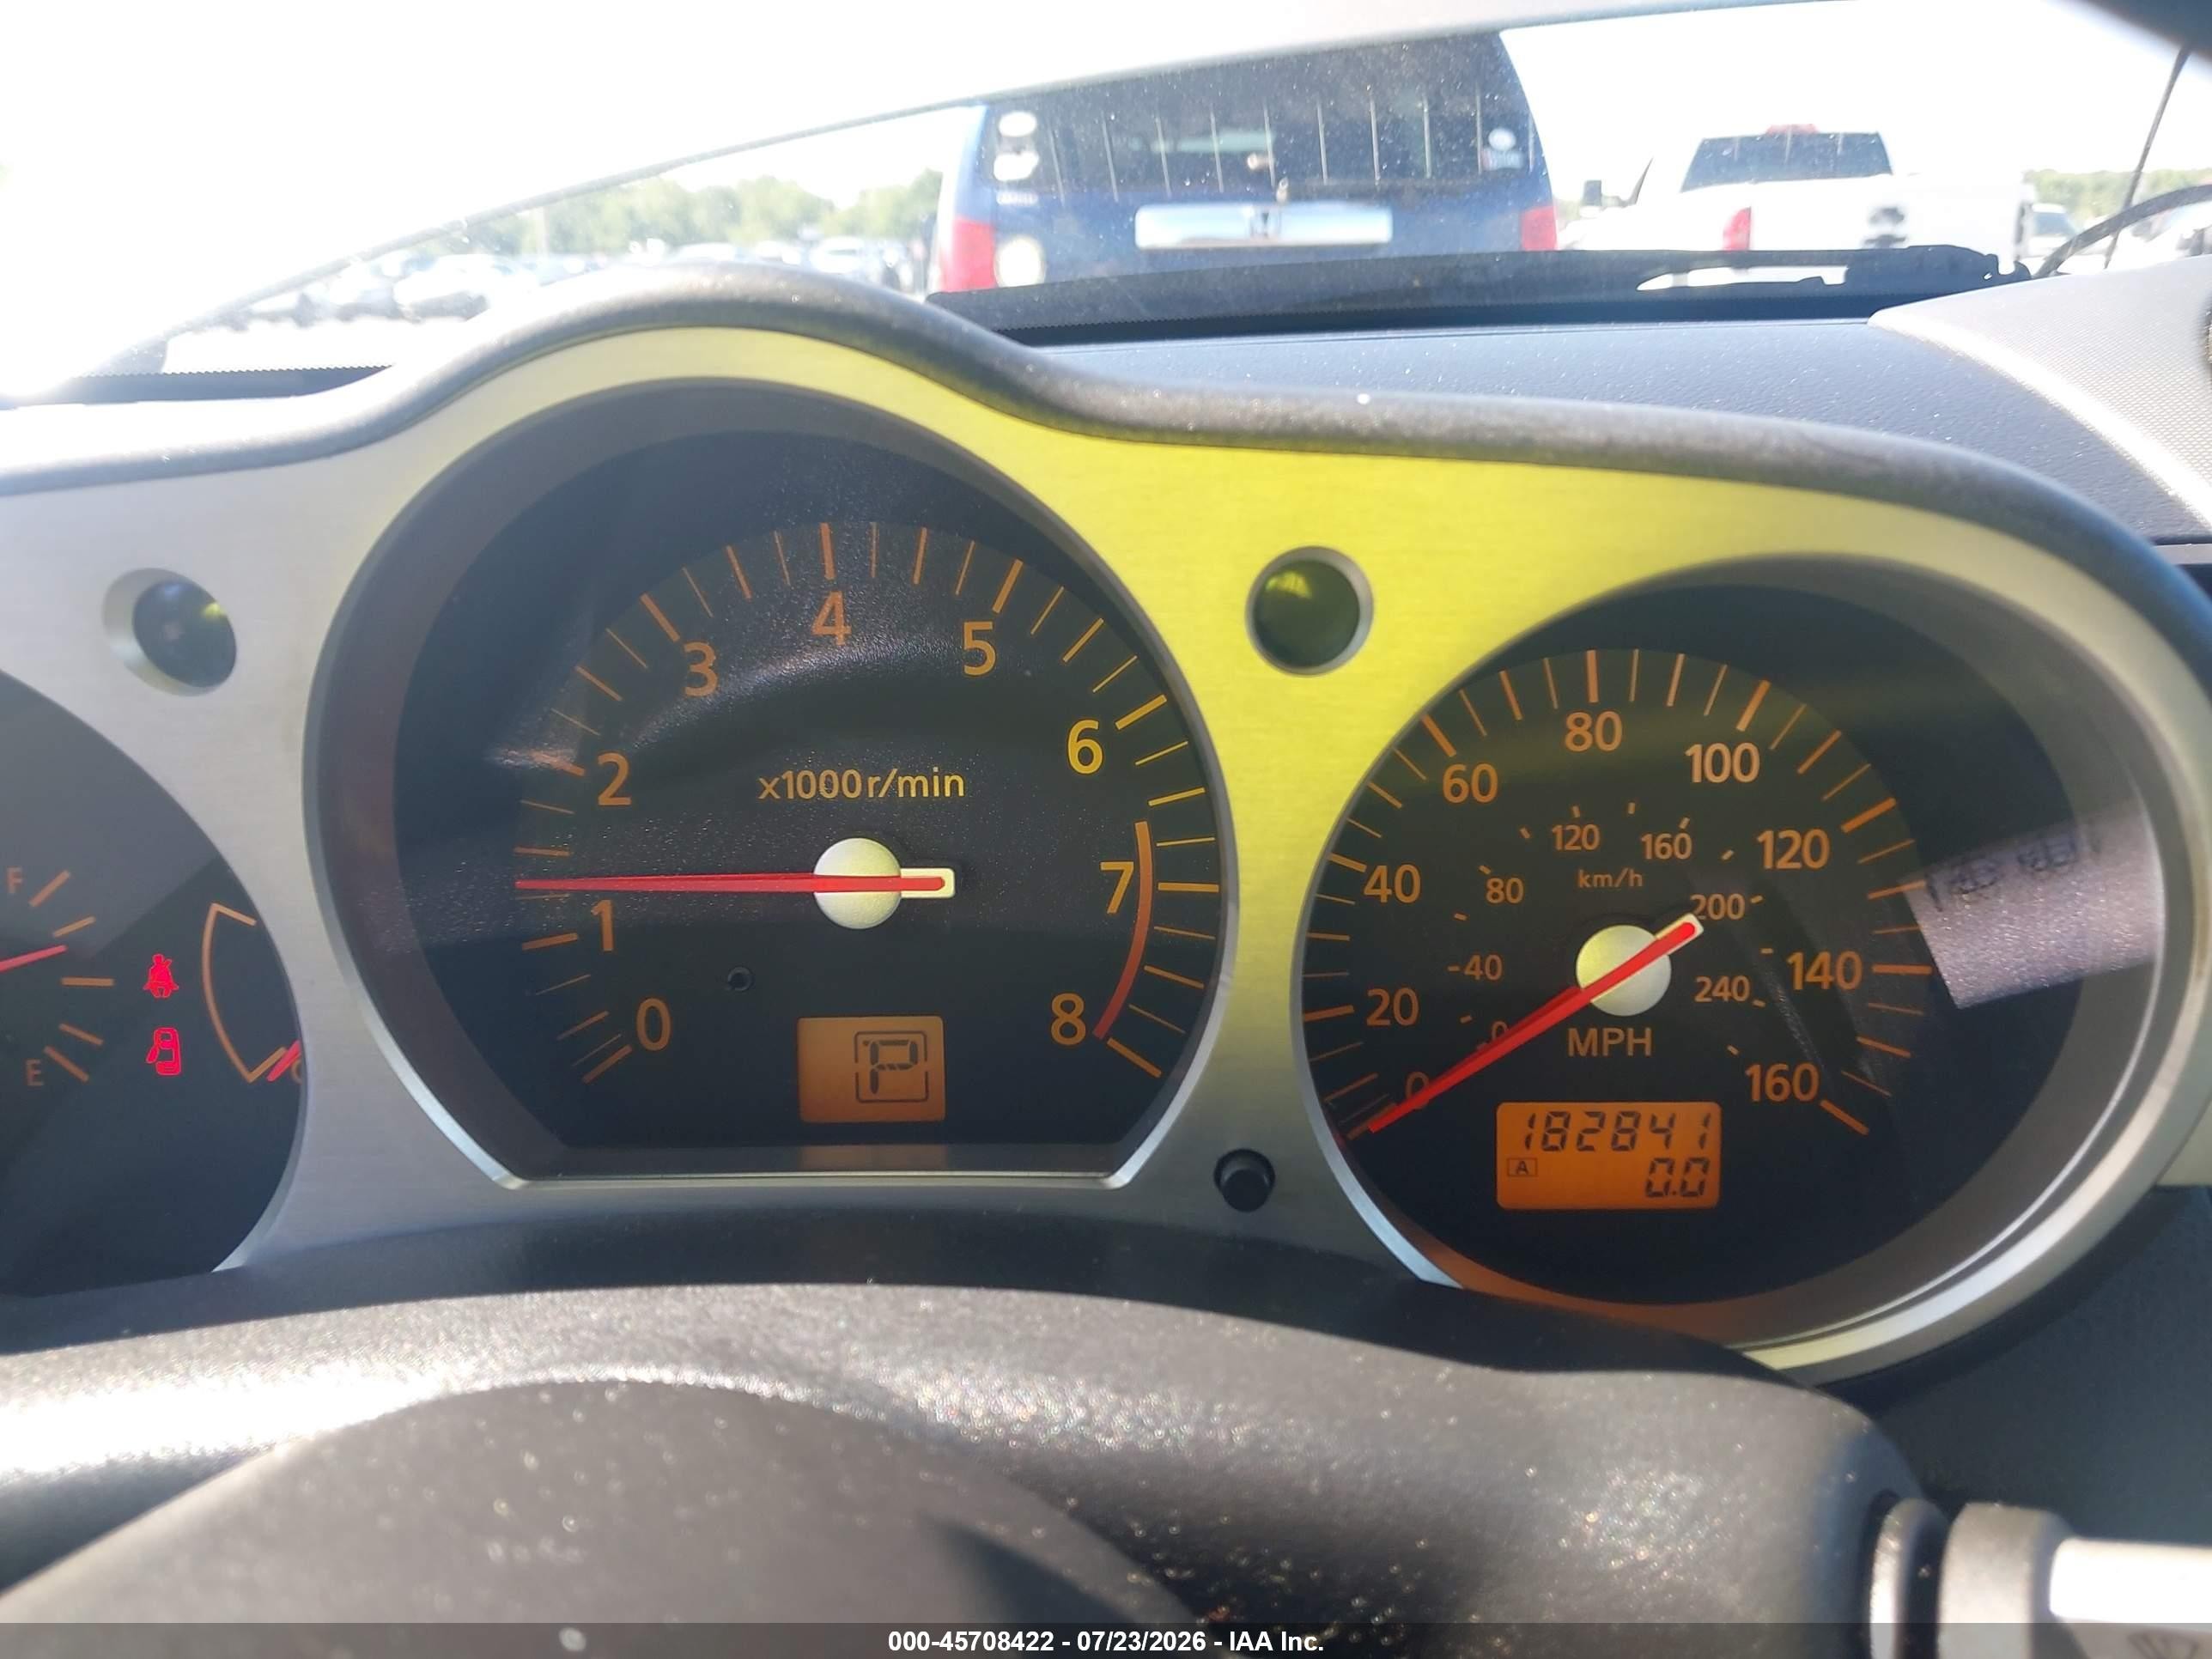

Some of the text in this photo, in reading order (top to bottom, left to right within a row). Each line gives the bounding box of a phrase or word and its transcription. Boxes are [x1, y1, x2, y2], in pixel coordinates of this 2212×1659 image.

[811, 591, 852, 645] 4
[963, 621, 996, 675] 5
[685, 642, 719, 697] 3
[1067, 720, 1102, 775] 6
[1565, 712, 1622, 752] 80
[597, 753, 632, 805] 2
[1442, 763, 1498, 803] 60
[1686, 744, 1759, 783] 100
[1553, 824, 1599, 851] 120
[1641, 832, 1692, 859] 160
[1757, 830, 1830, 869] 120
[7, 866, 22, 893] F
[1100, 862, 1134, 914] 7
[1364, 864, 1420, 903] 40
[1486, 877, 1523, 903] 80
[1578, 869, 1643, 888] km/h
[592, 901, 615, 952] 1
[1690, 894, 1745, 921] 200
[1695, 976, 1750, 1003] 240
[1787, 951, 1862, 991] 140
[637, 998, 671, 1051] 0
[1051, 994, 1085, 1046] 8
[1366, 989, 1419, 1026] 20
[1568, 1029, 1652, 1057] MPH
[26, 1060, 43, 1086] E
[863, 1040, 919, 1094] P
[1747, 1063, 1820, 1103] 160
[1524, 1111, 1711, 1152] 182841
[1515, 1161, 1529, 1175] A
[1645, 1158, 1710, 1198] 0.0
